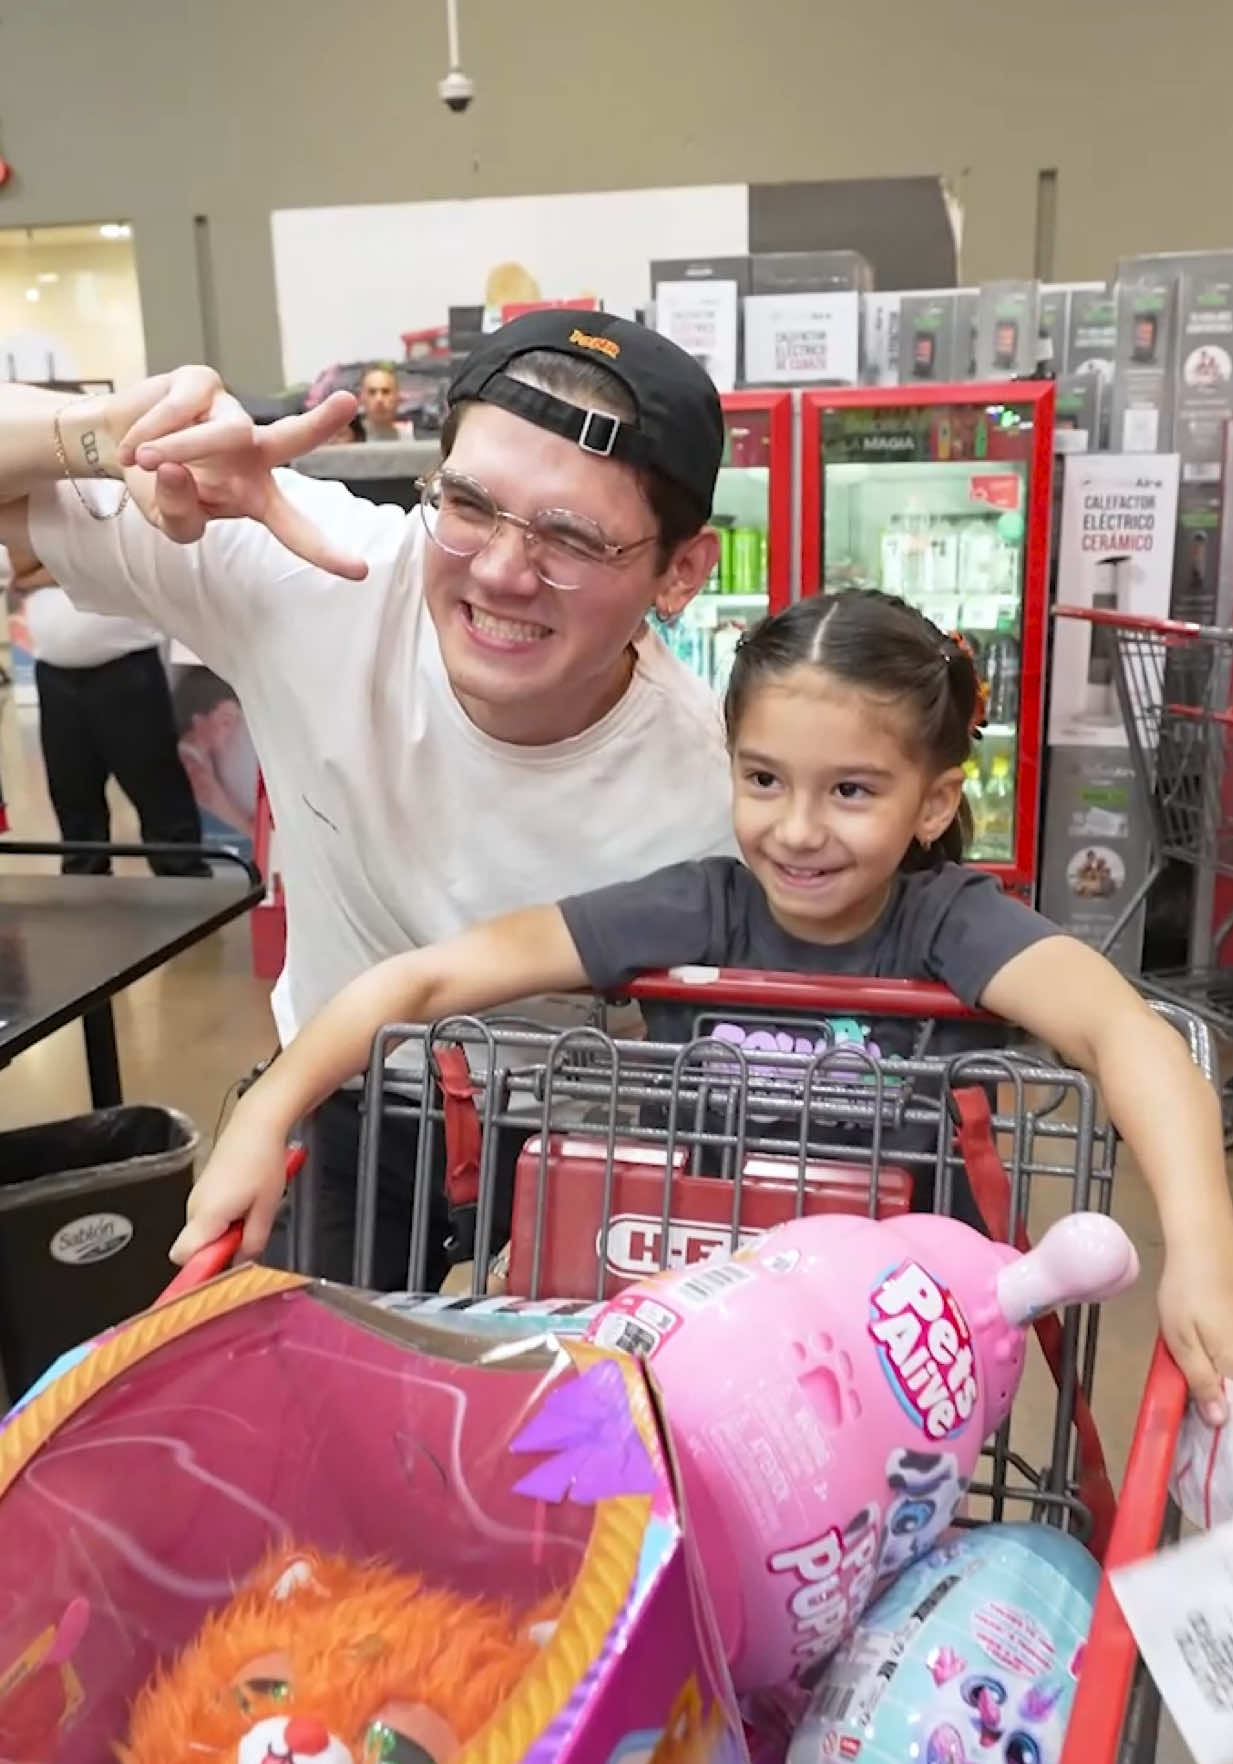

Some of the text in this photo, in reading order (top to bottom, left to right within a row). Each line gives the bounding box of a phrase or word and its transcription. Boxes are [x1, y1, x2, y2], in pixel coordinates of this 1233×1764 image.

[863, 436, 915, 450] MAGIA
[1083, 495, 1156, 510] CALEFACTOR
[1083, 512, 1155, 531] ELÉCTRICO
[1081, 532, 1153, 552] CERÁMICO
[874, 1262, 978, 1420] Pets
[871, 1311, 955, 1438] Alive
